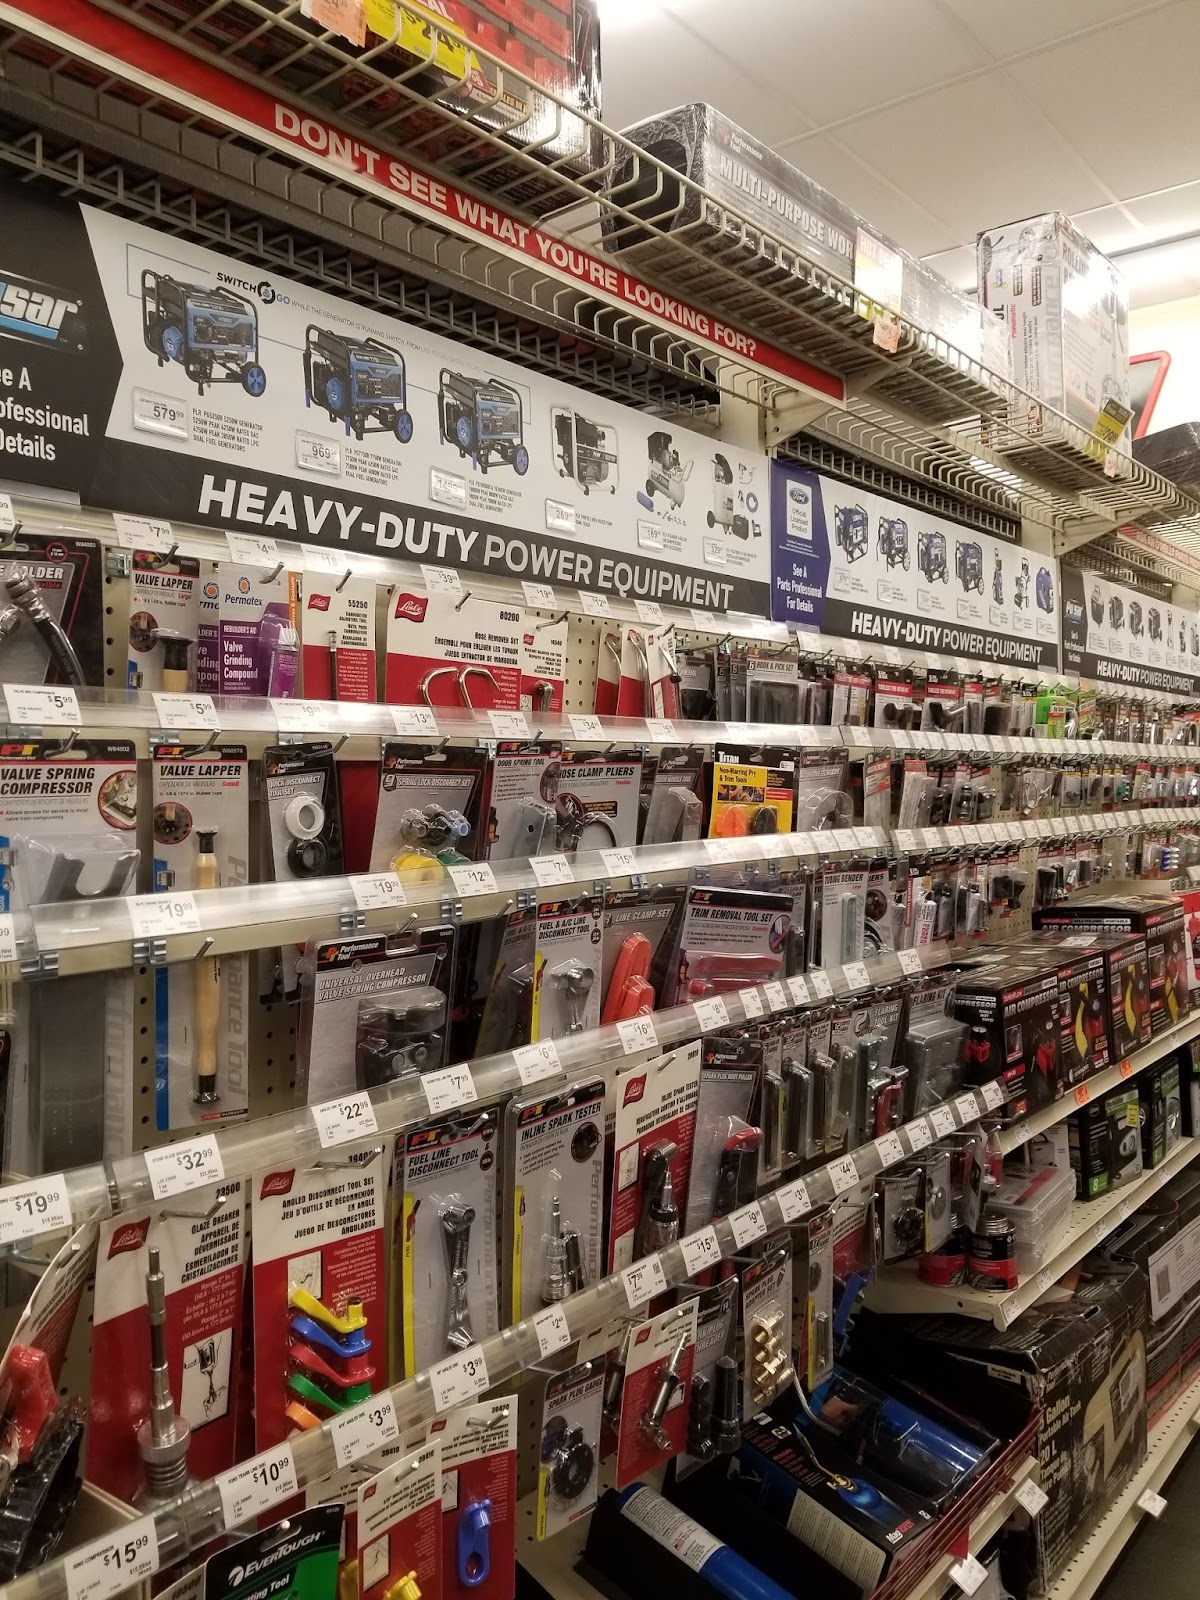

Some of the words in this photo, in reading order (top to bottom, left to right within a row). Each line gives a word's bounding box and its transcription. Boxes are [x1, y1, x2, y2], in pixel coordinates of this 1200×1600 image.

[720, 153, 830, 242] MULTI-PURPOSE
[275, 103, 380, 177] DON'T
[389, 163, 448, 211] SEE
[454, 194, 530, 250] WHAT
[537, 233, 618, 293] YOU'RE
[623, 276, 710, 336] LOOKING
[714, 315, 757, 356] FOR?
[216, 272, 257, 293] SWITCH
[276, 293, 290, 305] GO
[291, 299, 311, 312] WHILE
[311, 305, 322, 316] THE
[322, 309, 355, 328] GENERATOR
[19, 366, 33, 391] A
[208, 420, 221, 430] PEAK
[236, 426, 250, 436] RATED
[238, 417, 264, 432] GENERATOR
[208, 428, 221, 438] PEAK
[193, 433, 205, 443] DUAL
[206, 437, 217, 446] FUEL
[217, 439, 246, 453] GENERATORS
[791, 489, 808, 503] Ford
[197, 474, 480, 562] HEAVY-DUTY
[483, 534, 592, 586] POWER
[597, 560, 734, 610] EQUIPMENT
[792, 563, 803, 577] See
[134, 573, 159, 587] VALVE
[160, 576, 193, 591] LAPPER
[777, 577, 791, 591] Parts
[792, 579, 823, 598] Professional
[224, 593, 263, 607] Permatex
[348, 600, 368, 609] 55250
[787, 595, 797, 609] For
[796, 597, 814, 613] Details
[500, 610, 520, 623] 80200
[459, 640, 472, 649] POUR
[510, 636, 519, 645] SET
[851, 611, 941, 647] HEAVY-DUTY
[943, 628, 985, 657] POWER
[986, 637, 1043, 664] EQUIPMENT
[223, 641, 244, 653] Valve
[223, 654, 253, 669] Grinding
[223, 667, 259, 680] Compound
[1097, 660, 1141, 683] HEAVY-DUTY
[1140, 669, 1162, 687] POWER
[1162, 674, 1195, 693] EQUIPMENT
[718, 751, 740, 764] TITAN
[0, 767, 43, 781] VALVE
[46, 767, 96, 780] SPRING
[160, 765, 195, 777] VALVE
[198, 765, 242, 777] LAPPER
[577, 767, 603, 778] CLAMP
[605, 766, 635, 776] PLIERS
[719, 767, 748, 777] Non-Marring
[0, 781, 92, 795] COMPRESSOR
[221, 780, 240, 788] Small
[735, 776, 747, 784] Tools
[841, 873, 863, 882] BENDER
[632, 910, 656, 920] CLAMP
[657, 908, 671, 917] SET
[690, 908, 709, 918] TRIM
[710, 909, 742, 921] REMOVAL
[743, 912, 759, 922] TOOL
[760, 913, 774, 922] SET
[538, 921, 554, 931] FUEL
[538, 927, 576, 940] DISCONNECT
[576, 925, 590, 933] TOOL
[1041, 925, 1060, 933] AIR
[1061, 924, 1132, 933] COMPRESSOR
[340, 941, 379, 953] Performance
[337, 952, 352, 961] Tool
[318, 988, 344, 1001] VALVE
[345, 983, 375, 996] SPRING
[376, 973, 428, 992] COMPRESSOR
[319, 975, 364, 991] UNIVERSAL
[365, 967, 406, 982] OVERHEAD
[1004, 1003, 1016, 1018] AIR
[1017, 989, 1059, 1013] COMPRESSOR
[521, 1121, 546, 1142] INLINE
[548, 1111, 574, 1131] SPARK
[574, 1101, 602, 1119] TESTER
[408, 1153, 429, 1167] FUEL
[431, 1147, 452, 1161] LINE
[408, 1156, 461, 1179] DISCONNECT
[461, 1148, 480, 1163] TOOL
[282, 1195, 306, 1209] ANGLED
[308, 1184, 346, 1203] DISCONNECT
[347, 1180, 362, 1192] TOOL
[363, 1176, 375, 1187] SET
[281, 1209, 294, 1221] JEU
[295, 1202, 324, 1217] D'OUTILS
[325, 1200, 333, 1209] DE
[347, 1204, 356, 1213] EN
[356, 1197, 376, 1211] ANGLE
[191, 1221, 212, 1235] GLAZE
[213, 1209, 240, 1228] BREAKER
[294, 1225, 315, 1239] JUEGO
[316, 1223, 325, 1232] DE
[327, 1209, 376, 1230] DESCONECTORES
[341, 1219, 377, 1236] ANGULADOS
[200, 1227, 229, 1244] APPAREIL
[230, 1223, 240, 1234] DE
[184, 1247, 229, 1272] ESMERILADOR
[231, 1243, 239, 1254] DE
[180, 1253, 239, 1284] CRISTALIZACIONES
[547, 1397, 564, 1412] SPARK
[565, 1387, 580, 1403] PLUG
[580, 1377, 604, 1394] GAUGE
[1046, 1395, 1070, 1425] Gallon
[83, 1544, 116, 1564] COMPRESSOR
[269, 1574, 290, 1593] Tool
